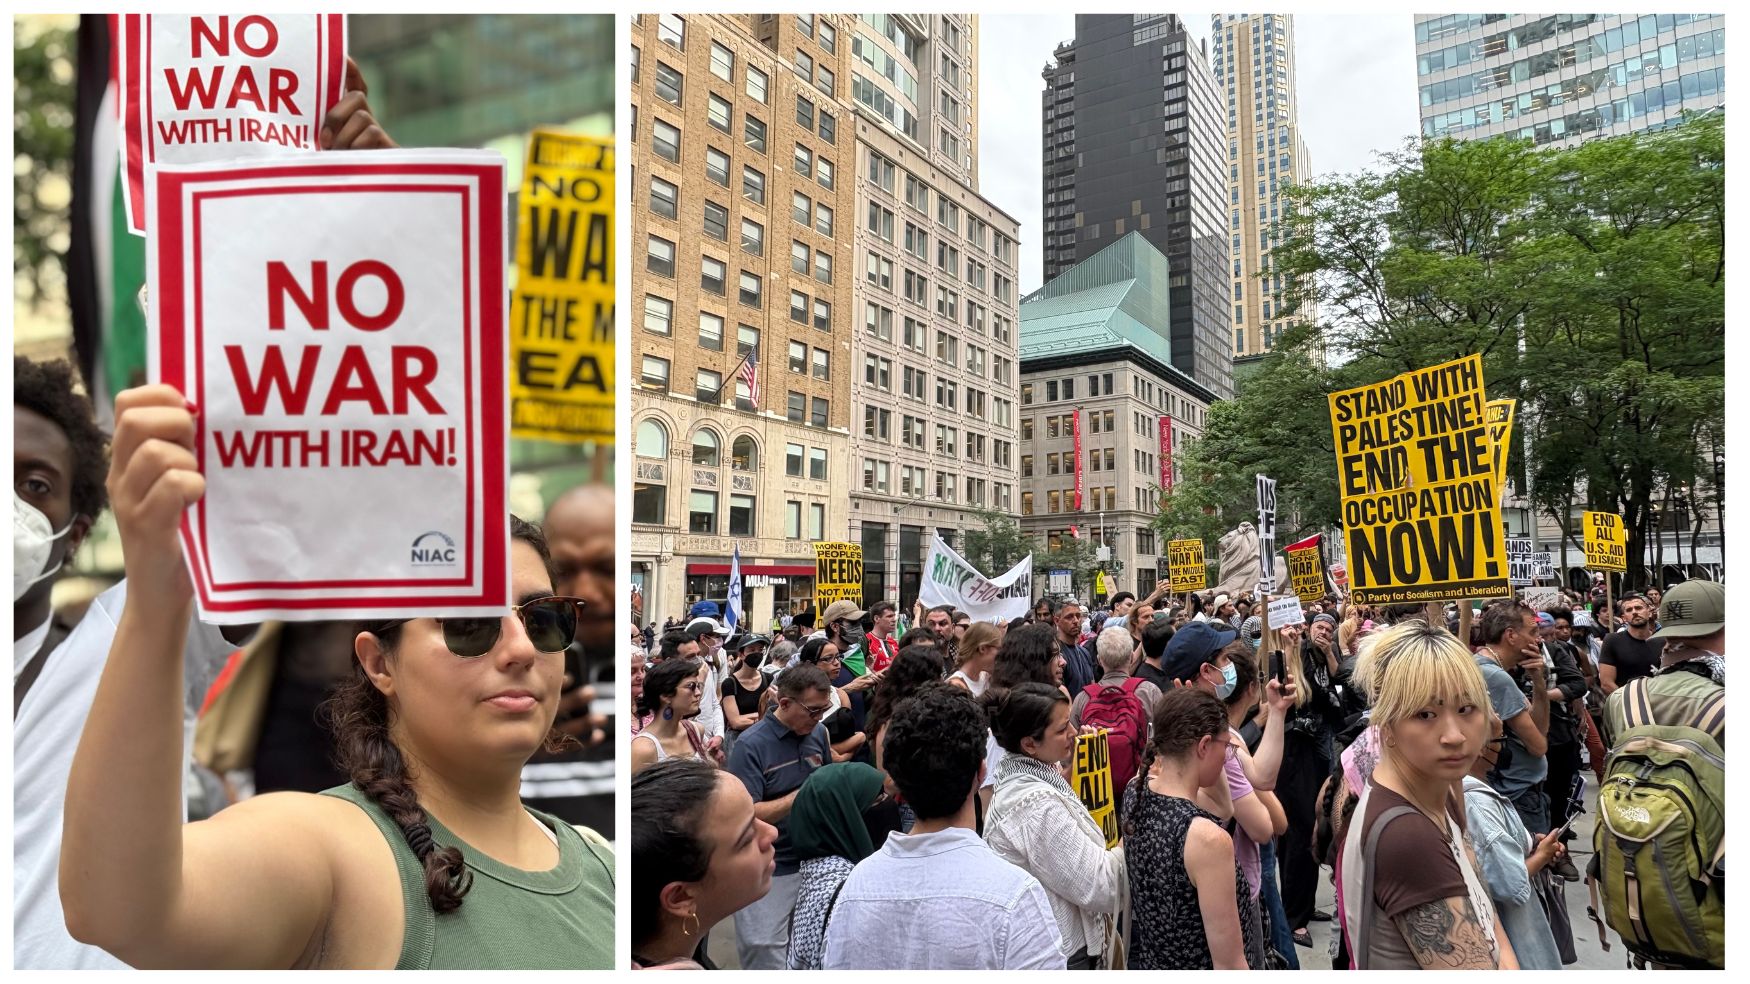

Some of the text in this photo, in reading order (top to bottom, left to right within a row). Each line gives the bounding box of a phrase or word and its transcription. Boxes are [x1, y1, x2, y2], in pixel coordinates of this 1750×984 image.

[190, 15, 278, 58] NO
[164, 66, 301, 115] WAR
[157, 118, 309, 149] WITH IRAN!
[531, 175, 601, 203] NO
[530, 206, 614, 284] WA
[266, 259, 404, 331] NO
[521, 295, 576, 341] THE
[225, 344, 445, 416] WAR
[519, 350, 614, 394] EA
[1335, 358, 1479, 423] STAND WITH
[1339, 392, 1484, 454] PALESTINE!
[213, 427, 457, 468] WITH IRAN!
[1343, 445, 1409, 496] END
[1416, 427, 1491, 483] THE
[1345, 479, 1493, 528] OCCUPATION
[1593, 513, 1615, 528] END
[1596, 527, 1615, 541] ALL
[411, 549, 455, 562] NIAC
[817, 550, 861, 558] PEOPLE'S
[1170, 551, 1203, 566] WAR IN
[1350, 511, 1499, 587] NOW!
[1505, 541, 1532, 553] ANDS
[1586, 542, 1624, 557] U.S. AID
[1587, 555, 1625, 567] TO ISRAEL!
[745, 574, 769, 587] MUJI
[818, 559, 862, 584] NEEDS
[1171, 565, 1204, 576] THE MIDDLE
[1172, 574, 1204, 585] EAST
[1291, 562, 1312, 576] WAR
[1507, 563, 1532, 580] AN!
[818, 588, 861, 596] NOT WAR
[1368, 585, 1508, 602] Party for Socialism and Liberation
[1077, 734, 1107, 775] END
[1081, 771, 1110, 811] ALL
